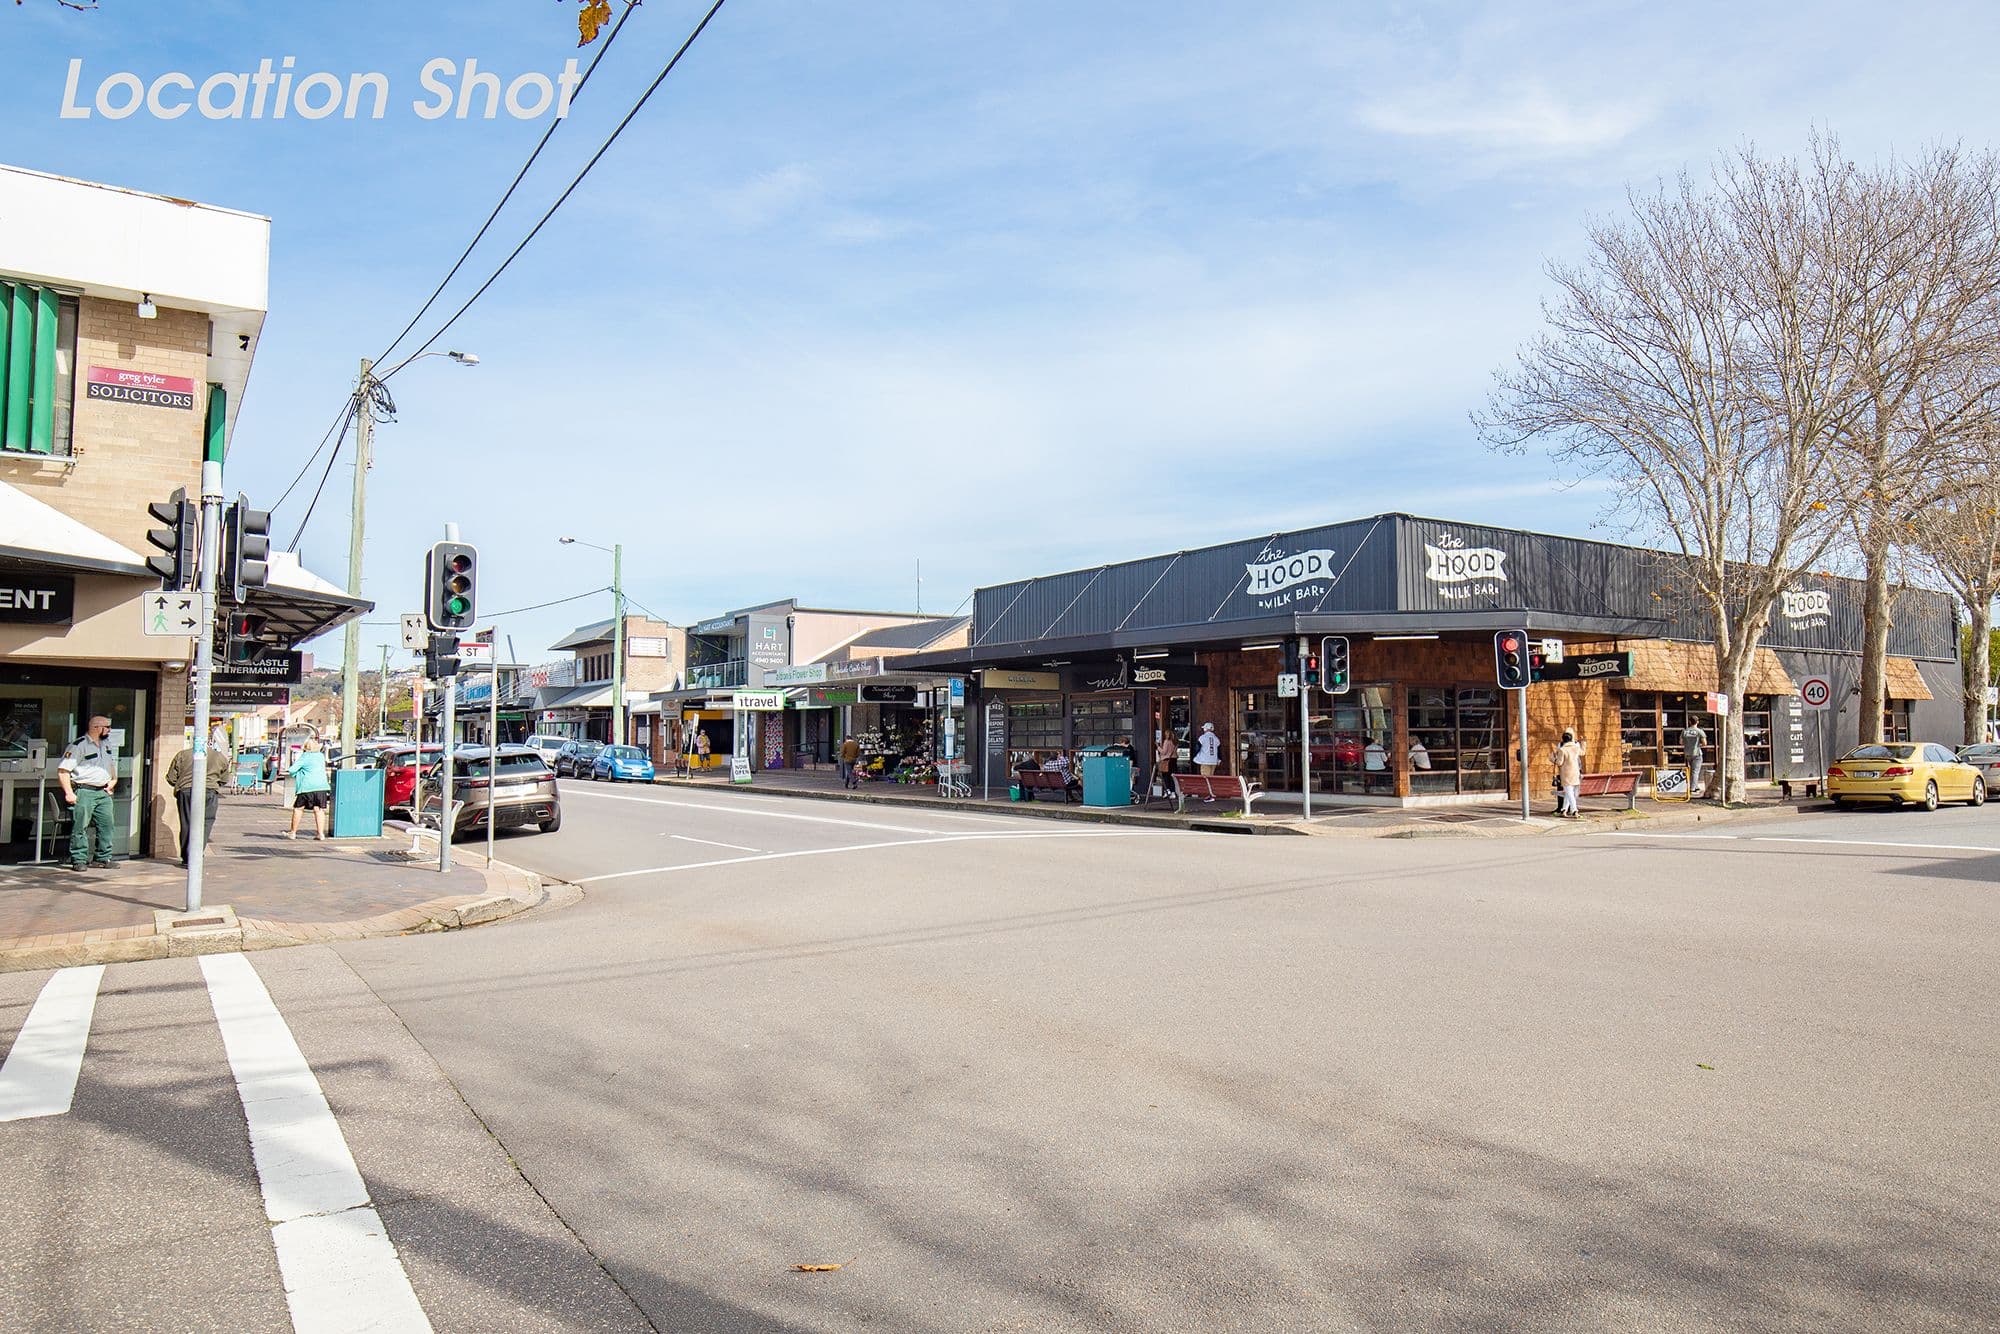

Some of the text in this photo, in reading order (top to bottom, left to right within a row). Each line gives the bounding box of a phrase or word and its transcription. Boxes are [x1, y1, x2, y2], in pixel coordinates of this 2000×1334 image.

[118, 372, 166, 385] greg tyler
[90, 384, 192, 407] SOLICITORS
[1438, 531, 1464, 548] the
[1258, 547, 1285, 562] the
[1257, 555, 1322, 589] HOOD
[1437, 553, 1495, 577] HOOD
[1264, 585, 1319, 609] MILK BAR
[1445, 583, 1495, 600] MILK BAR
[1788, 595, 1825, 613] HOOD
[466, 647, 478, 657] ST
[755, 642, 784, 651] HART
[248, 659, 289, 667] CASTLE
[1583, 662, 1614, 675] HOOD
[1138, 671, 1162, 680] HOOD
[1807, 686, 1825, 699] 40
[739, 695, 778, 707] itravel
